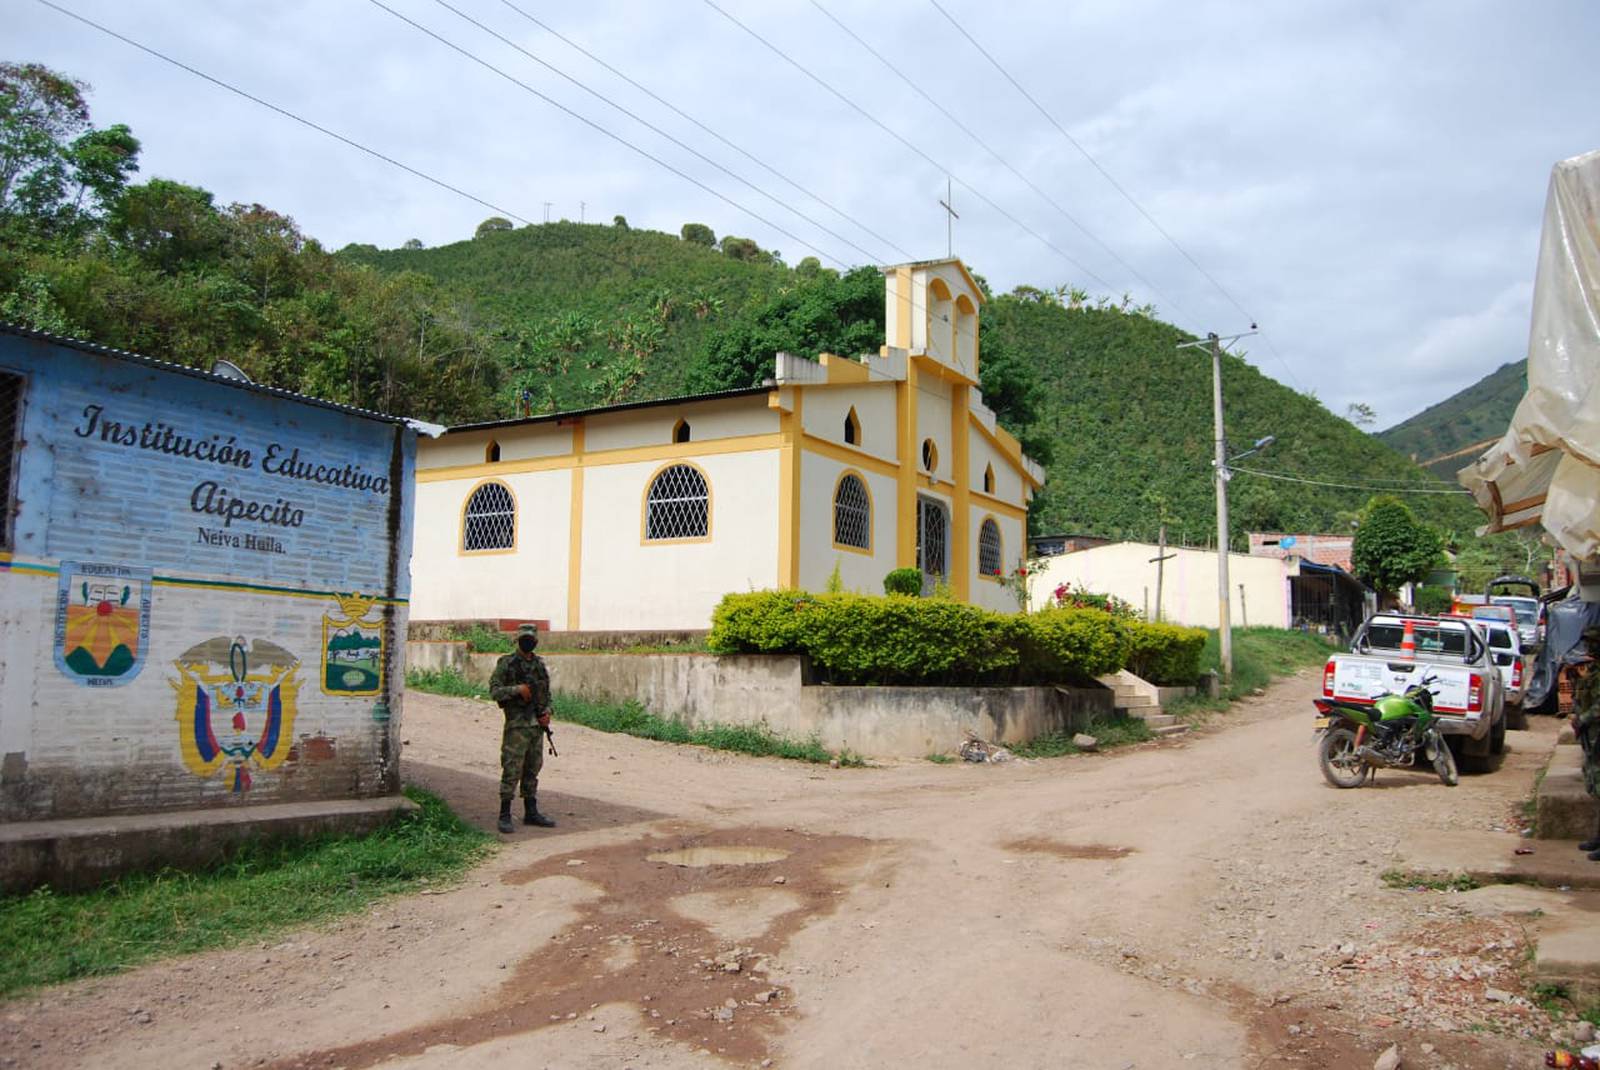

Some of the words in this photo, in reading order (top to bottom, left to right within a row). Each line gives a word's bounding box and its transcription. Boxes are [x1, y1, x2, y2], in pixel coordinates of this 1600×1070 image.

[74, 404, 252, 469] Institución
[261, 443, 390, 494] Educativa
[190, 480, 304, 528] Aipecito
[198, 528, 240, 549] Neiva
[245, 532, 286, 554] Huila.
